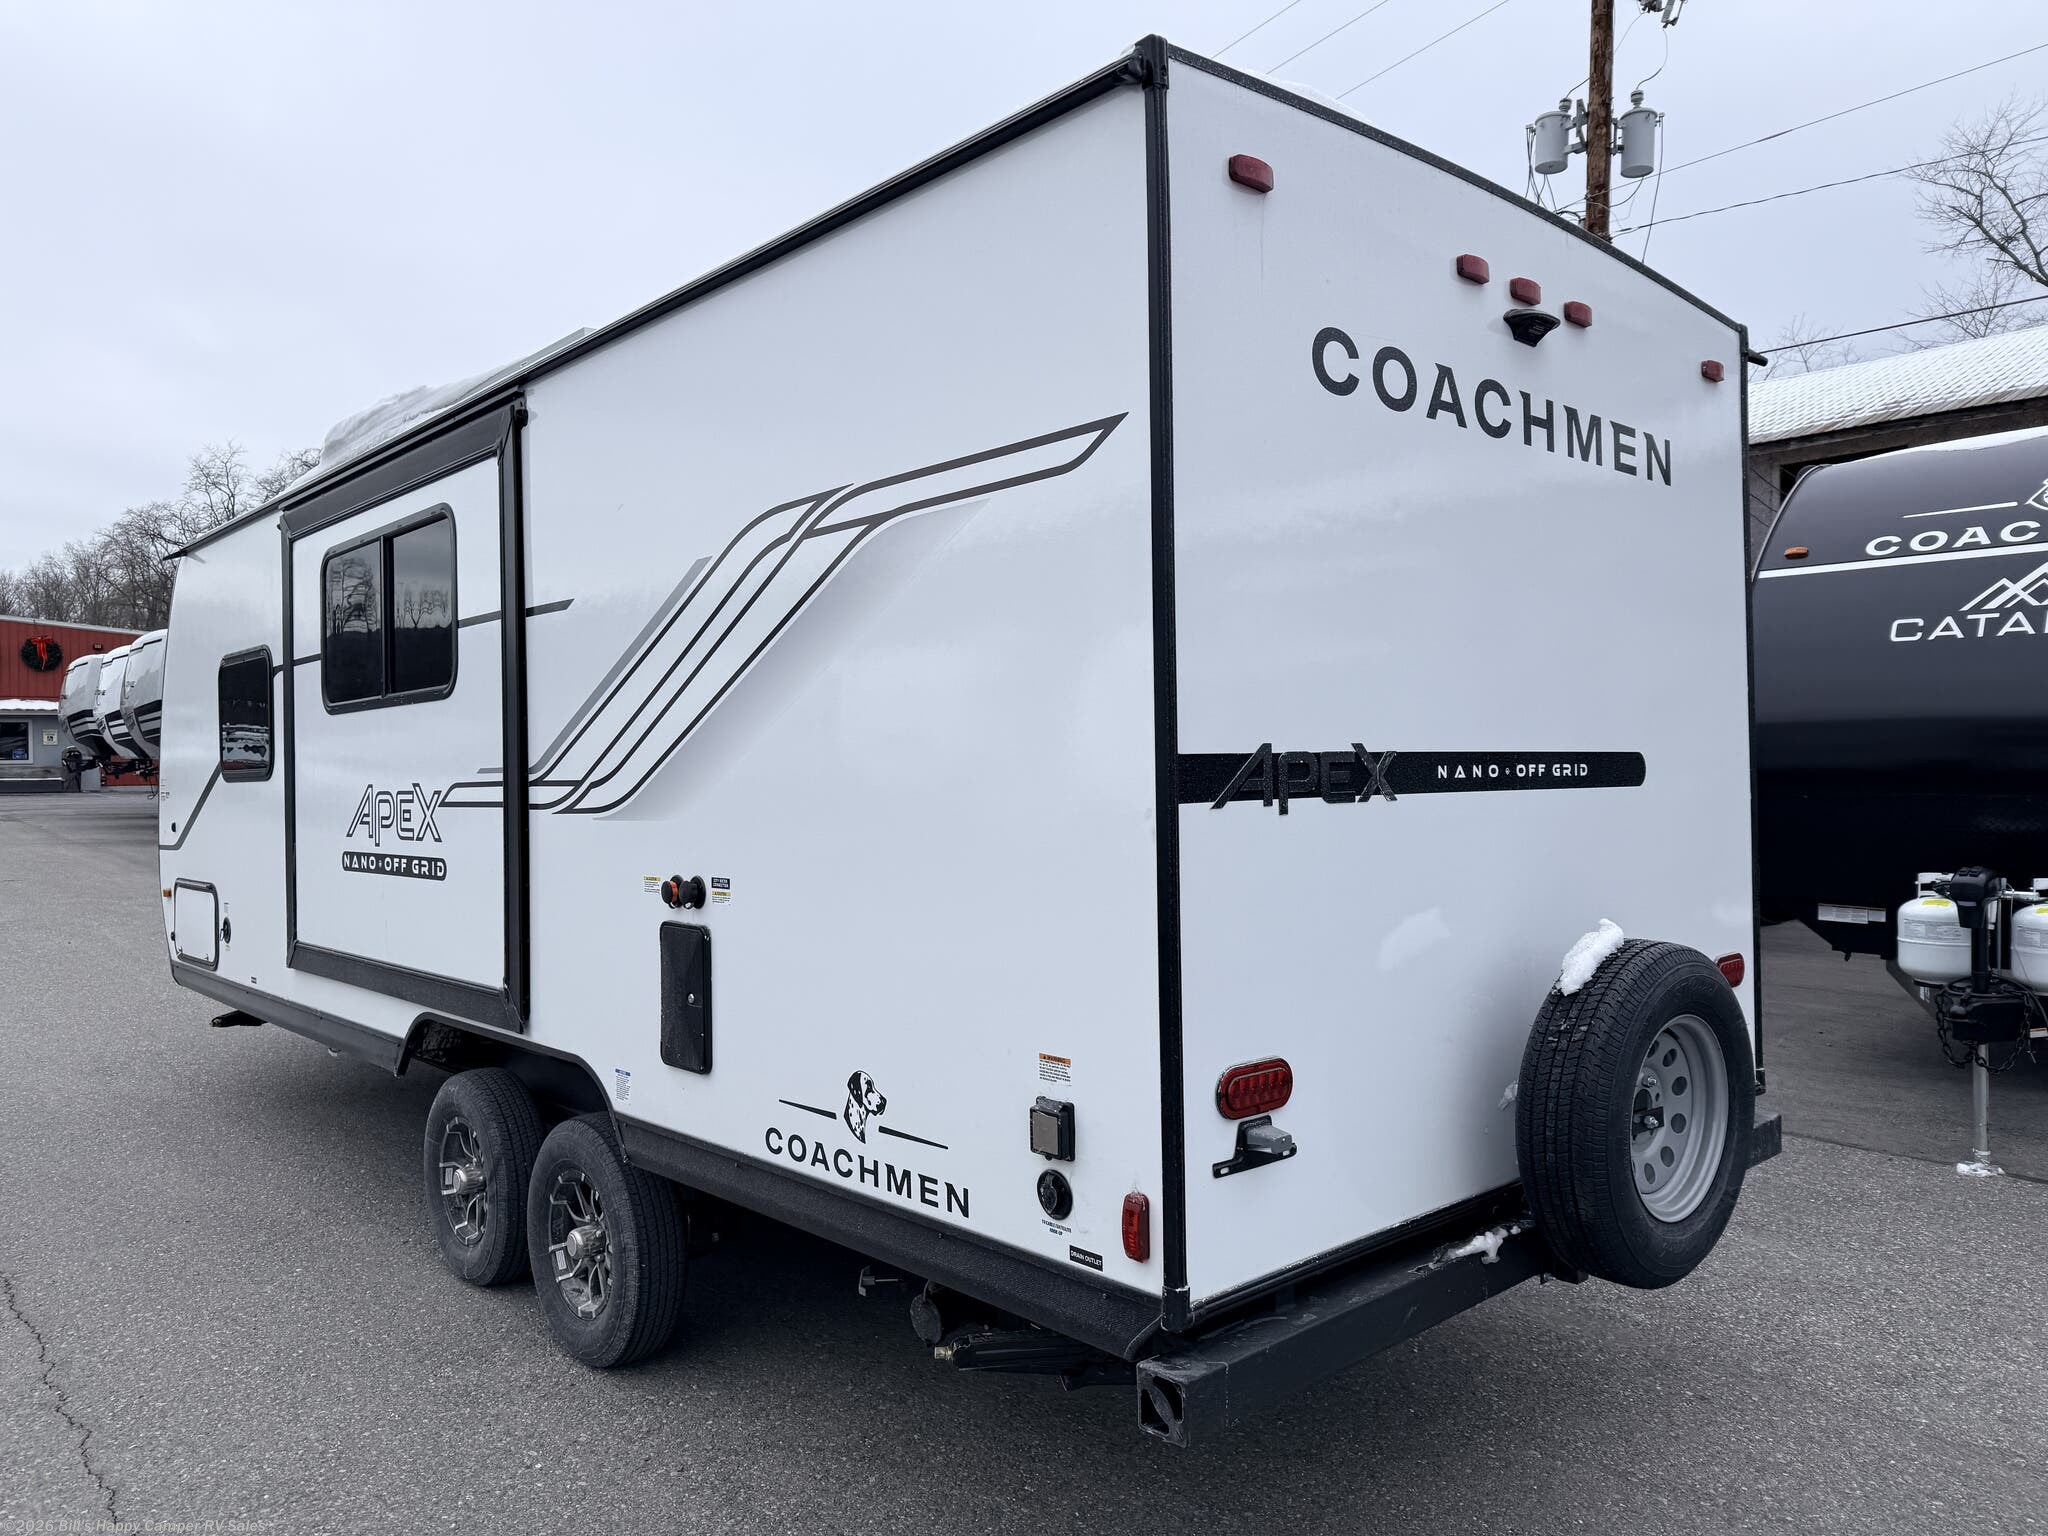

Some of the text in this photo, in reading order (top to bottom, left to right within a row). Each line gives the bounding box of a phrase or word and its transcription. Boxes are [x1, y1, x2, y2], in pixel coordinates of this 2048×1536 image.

[1312, 327, 1671, 486] COACHMEN
[1866, 520, 2041, 556] COAC
[1210, 743, 1398, 815] APEX
[1437, 763, 1588, 779] NANO OFF GRID
[346, 783, 442, 847] APEX
[343, 854, 444, 877] NANO OFF GRID
[765, 1127, 969, 1218] COACHMEN
[1070, 1249, 1102, 1266] DRAIN OUTLET
